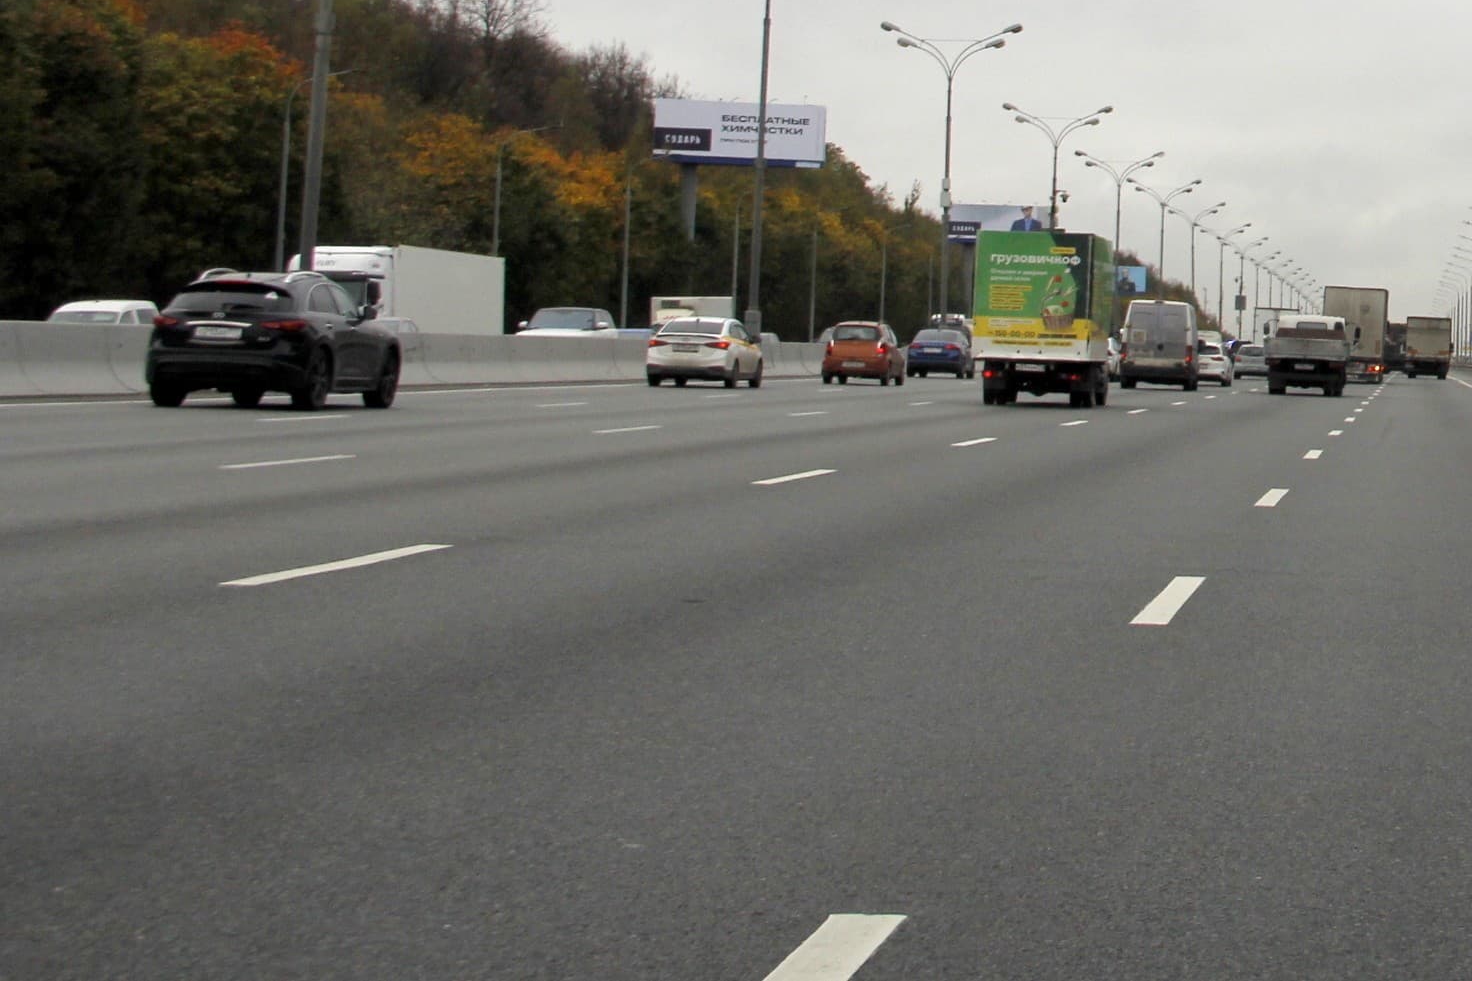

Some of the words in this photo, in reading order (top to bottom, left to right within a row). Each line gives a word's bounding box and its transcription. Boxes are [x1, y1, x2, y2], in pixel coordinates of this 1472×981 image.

[721, 125, 803, 135] ХИМЧСТКИ
[664, 134, 702, 145] СУДАРЬ
[990, 253, 1081, 266] грузовичкоф
